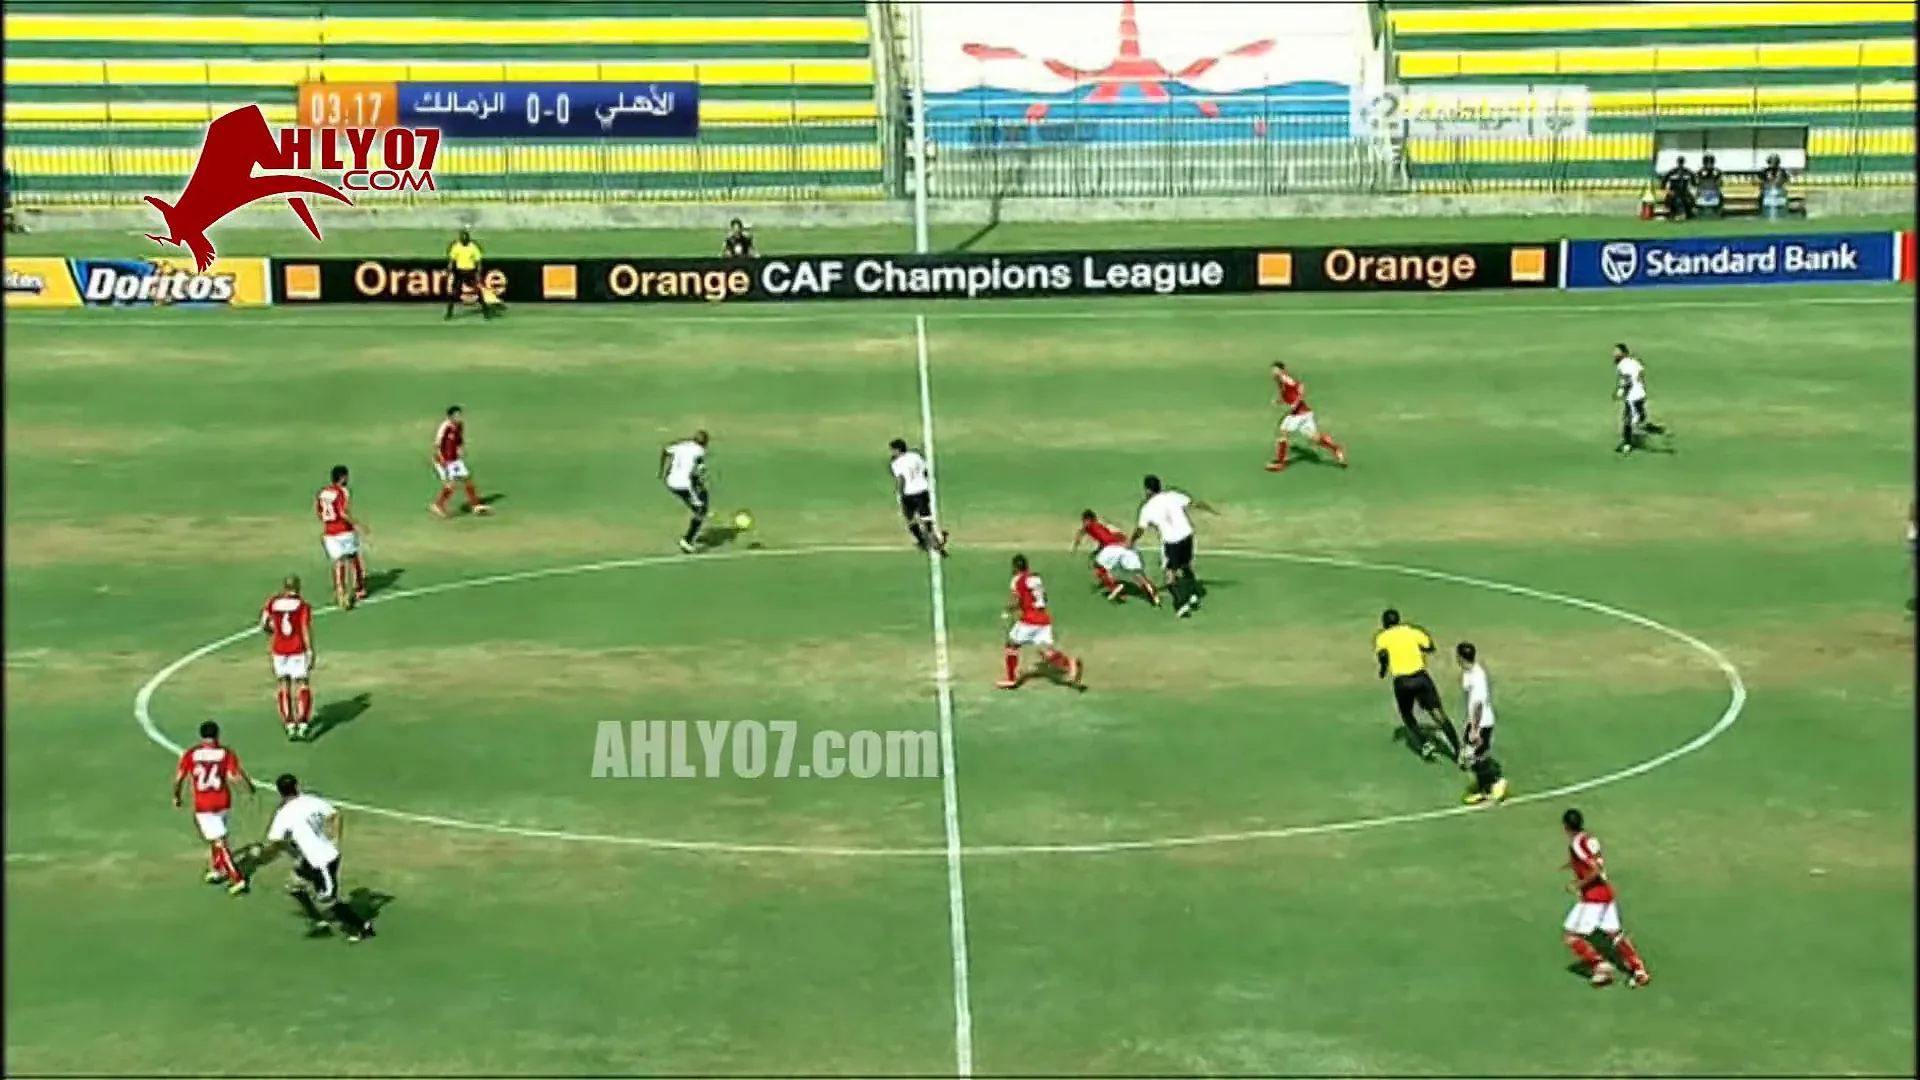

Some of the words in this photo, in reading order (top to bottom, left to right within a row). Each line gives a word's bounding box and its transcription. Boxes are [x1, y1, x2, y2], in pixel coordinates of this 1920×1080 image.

[1324, 249, 1476, 288] Orange
[1645, 246, 1776, 278] Standard
[1785, 242, 1858, 271] Bank
[85, 267, 235, 300] Doritos
[609, 264, 750, 300] Orange
[762, 261, 844, 293] CAF
[854, 260, 1072, 296] Champions
[1083, 257, 1225, 292] League
[193, 763, 222, 792] 24
